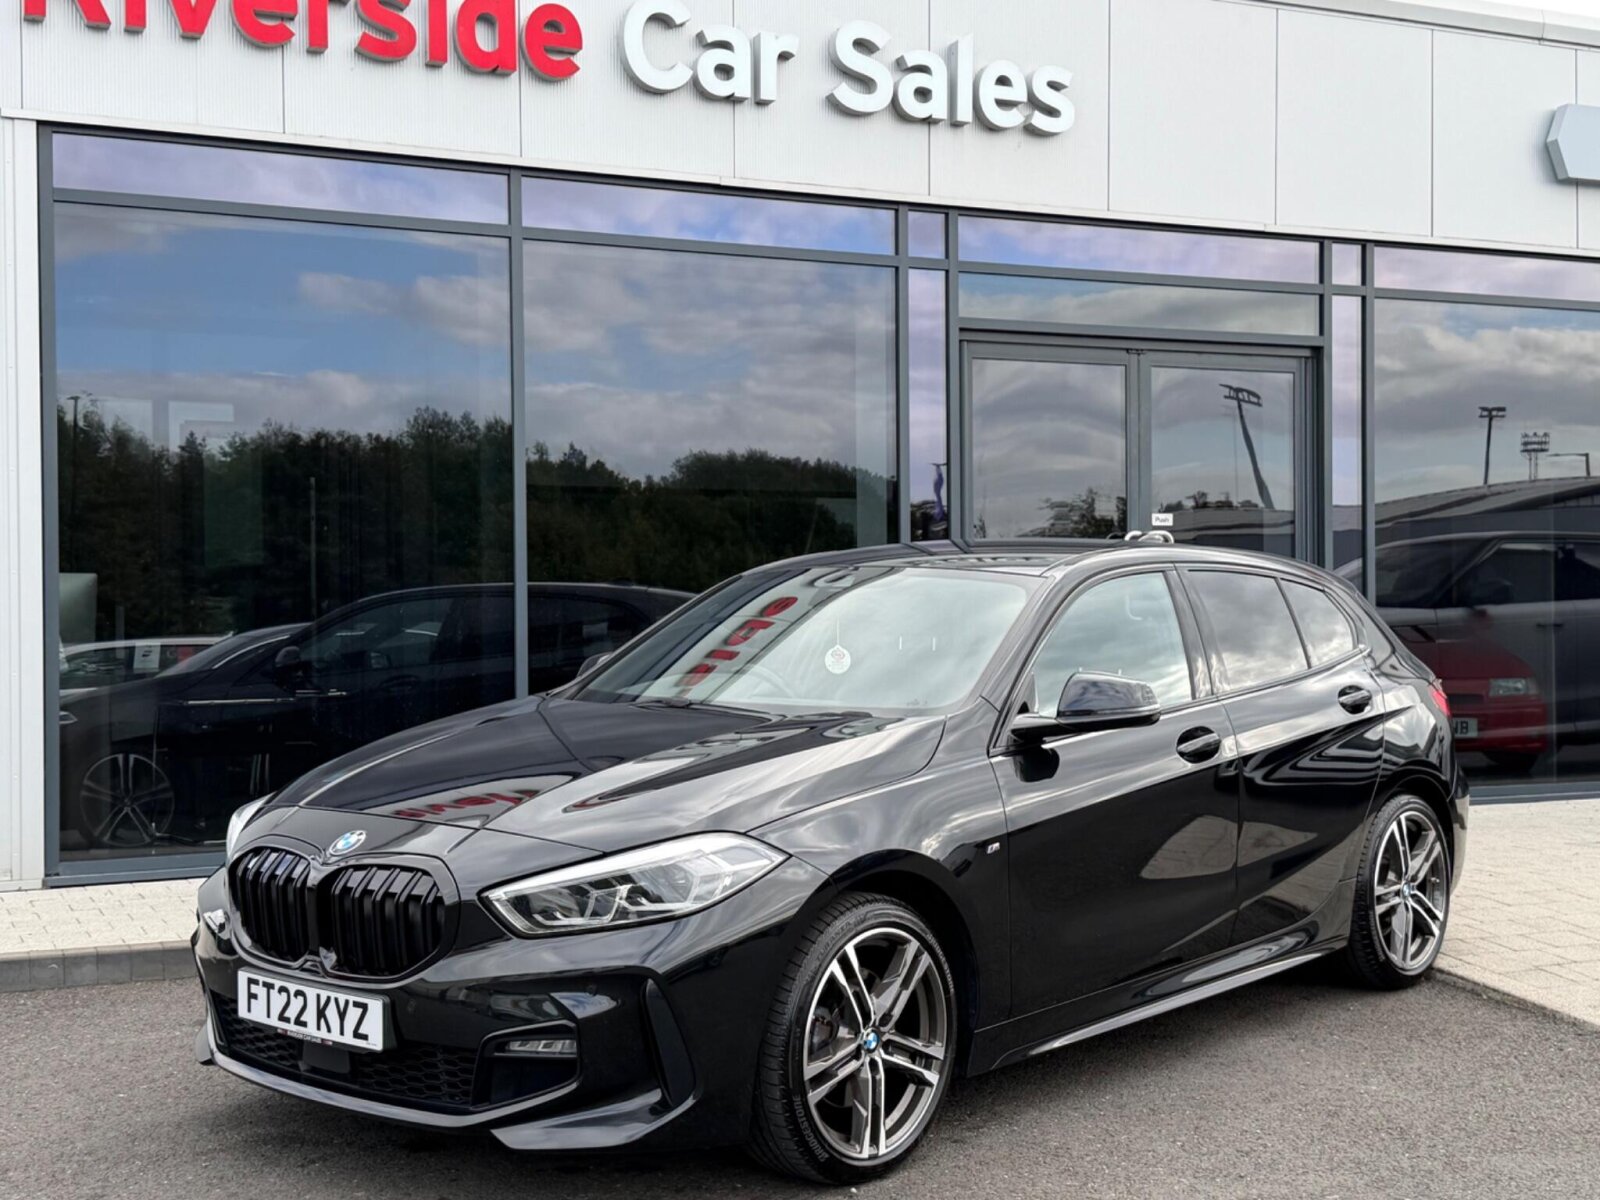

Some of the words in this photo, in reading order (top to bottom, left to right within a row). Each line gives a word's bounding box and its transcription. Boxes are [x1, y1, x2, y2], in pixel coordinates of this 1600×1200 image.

[23, 0, 584, 82] erside
[621, 0, 799, 105] Car
[826, 19, 1075, 136] Sales
[247, 976, 309, 1029] FT22
[316, 993, 370, 1042] KYZ
